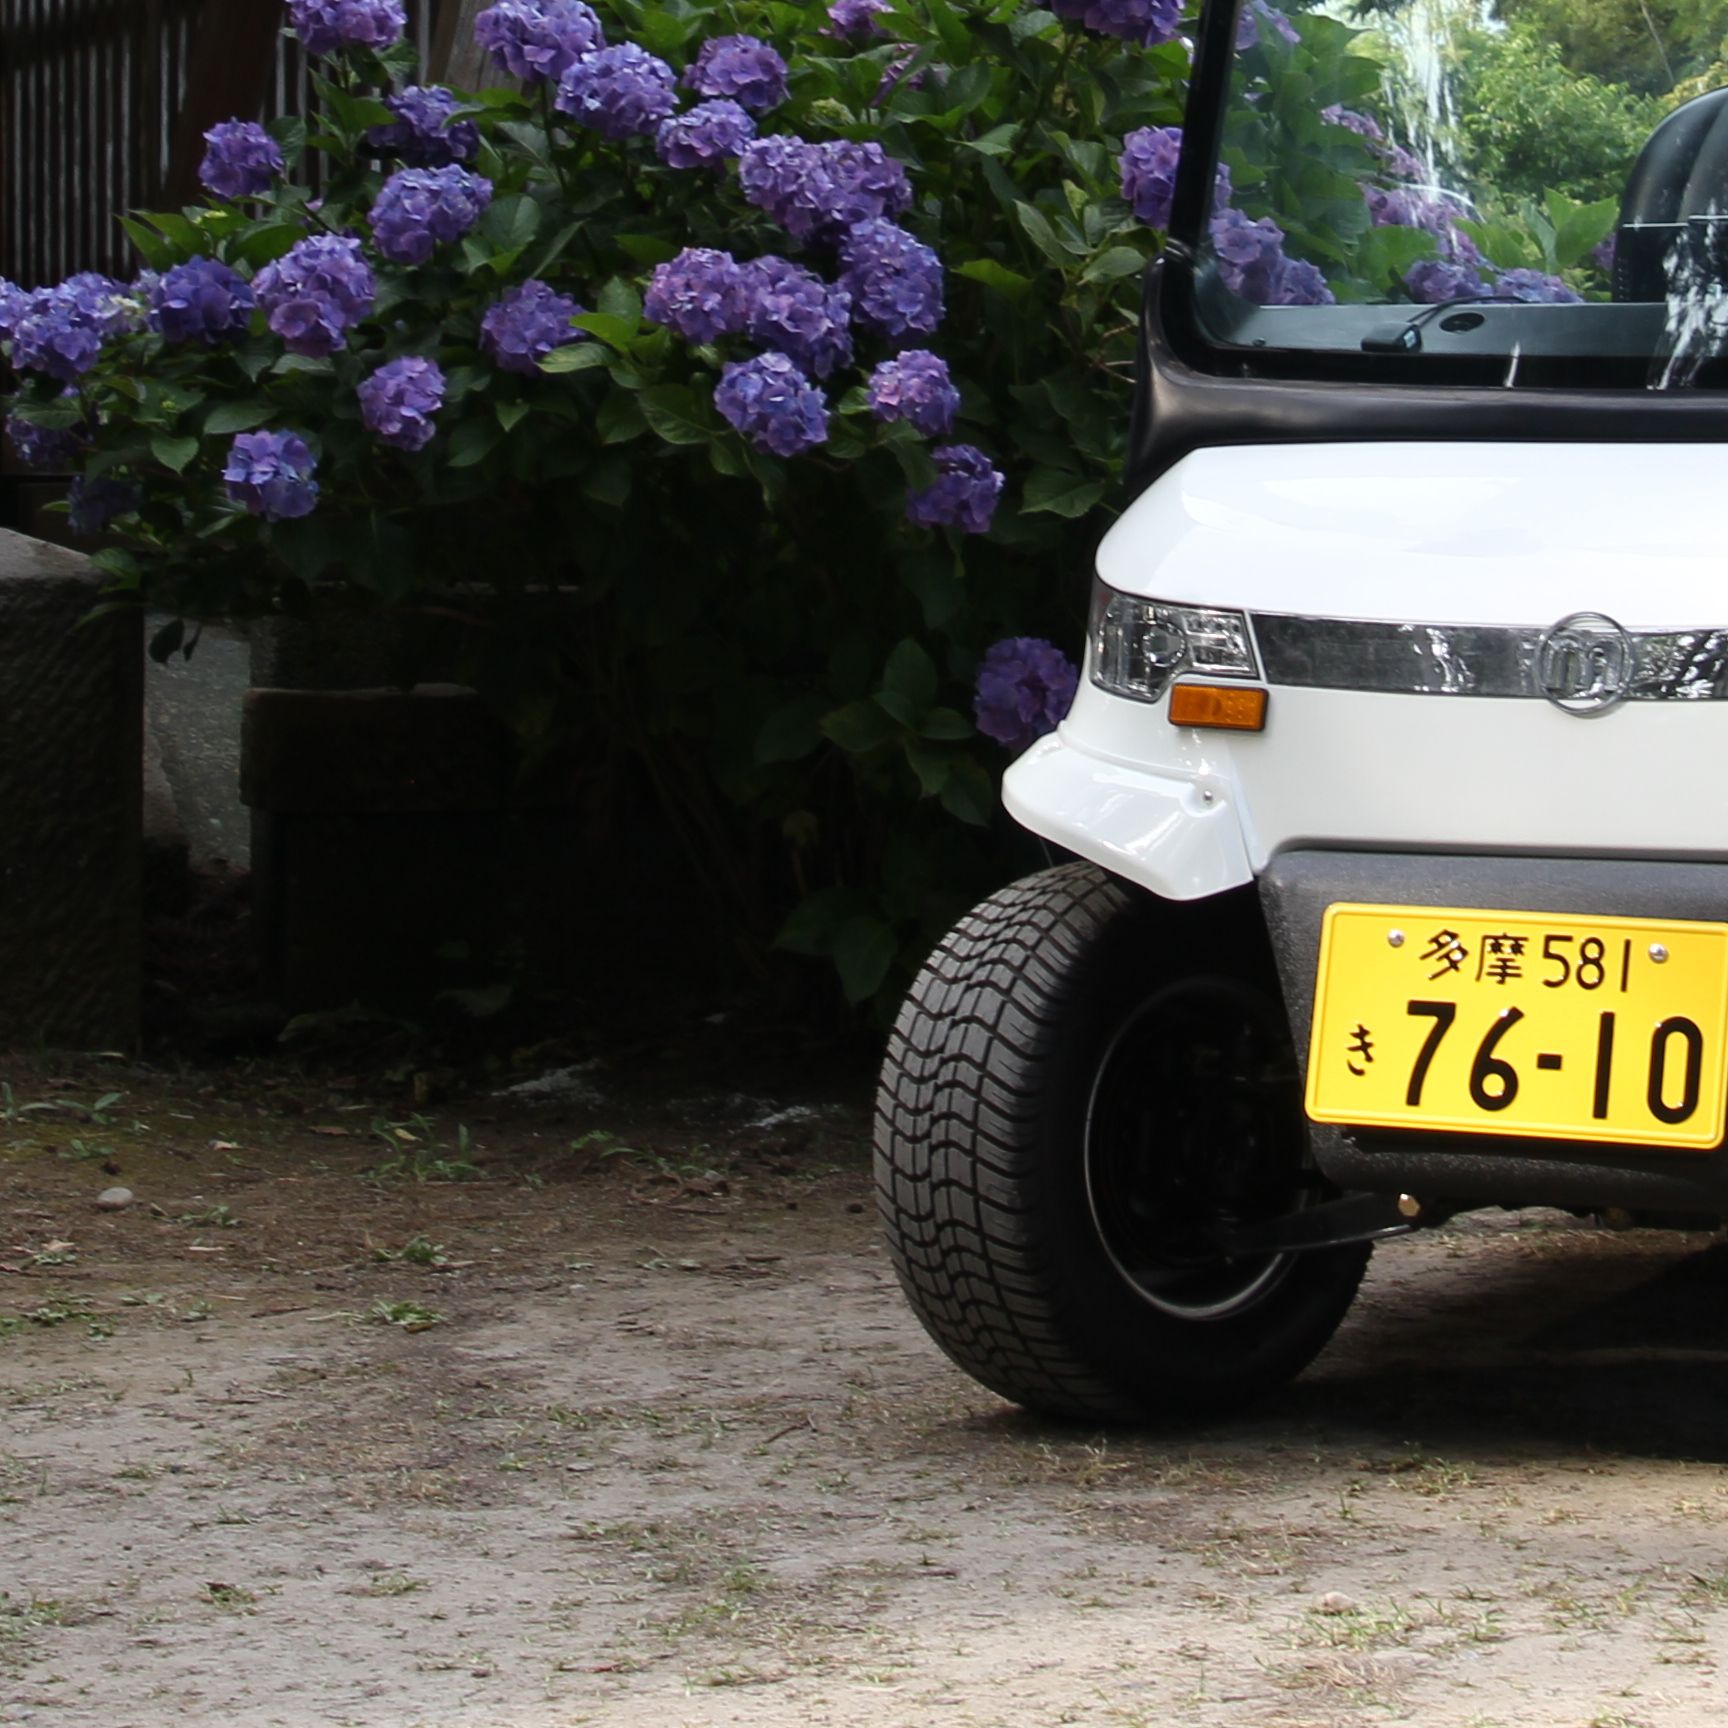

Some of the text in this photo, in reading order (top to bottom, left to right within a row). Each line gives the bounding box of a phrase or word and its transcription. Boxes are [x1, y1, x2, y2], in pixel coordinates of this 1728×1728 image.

[1419, 929, 1632, 993] 多摩 581
[1346, 999, 1704, 1125] き 76-10
